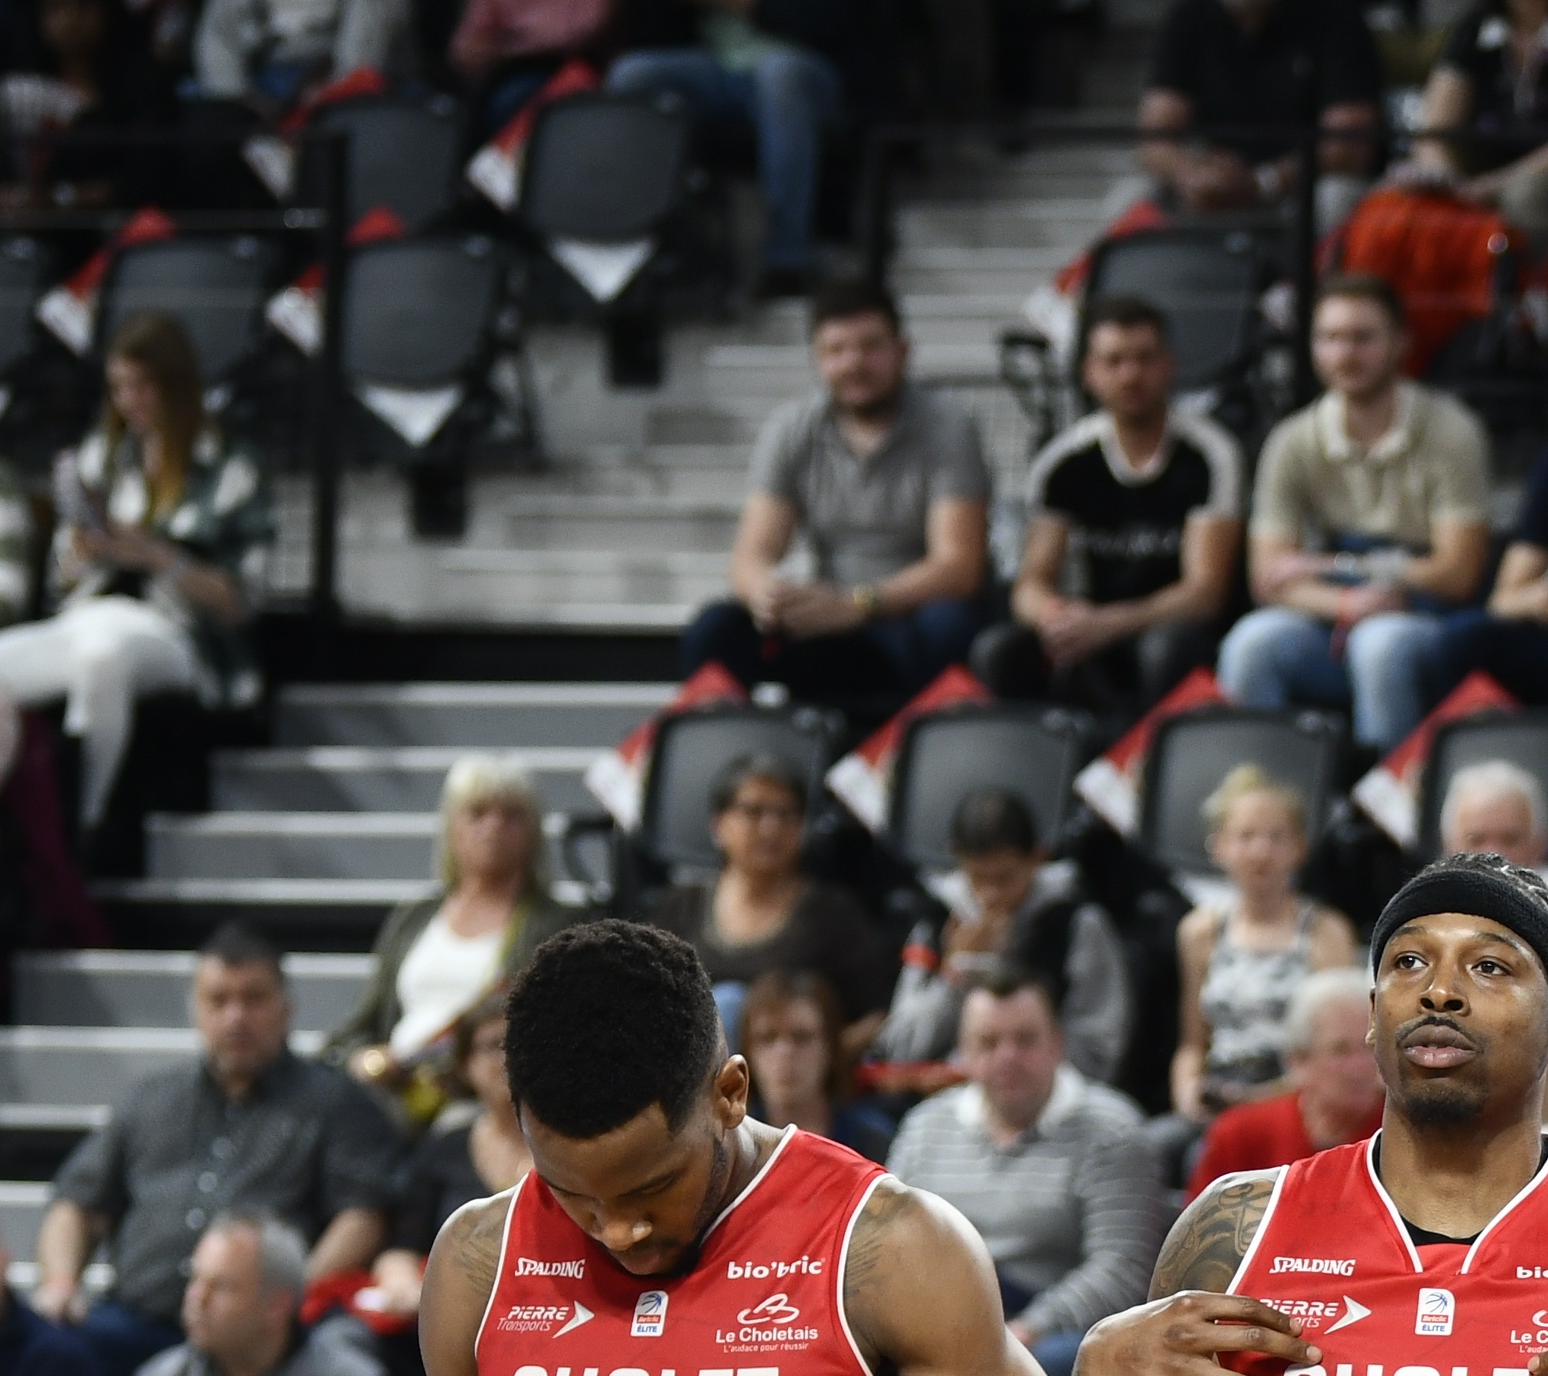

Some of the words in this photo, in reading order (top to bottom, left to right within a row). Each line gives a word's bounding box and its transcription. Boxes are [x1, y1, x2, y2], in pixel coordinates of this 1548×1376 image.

[515, 1257, 585, 1279] SPALDING
[1269, 1256, 1356, 1277] SPALDING
[715, 1329, 736, 1344] Le
[739, 1326, 819, 1342] Choletais
[1510, 1330, 1533, 1344] Le
